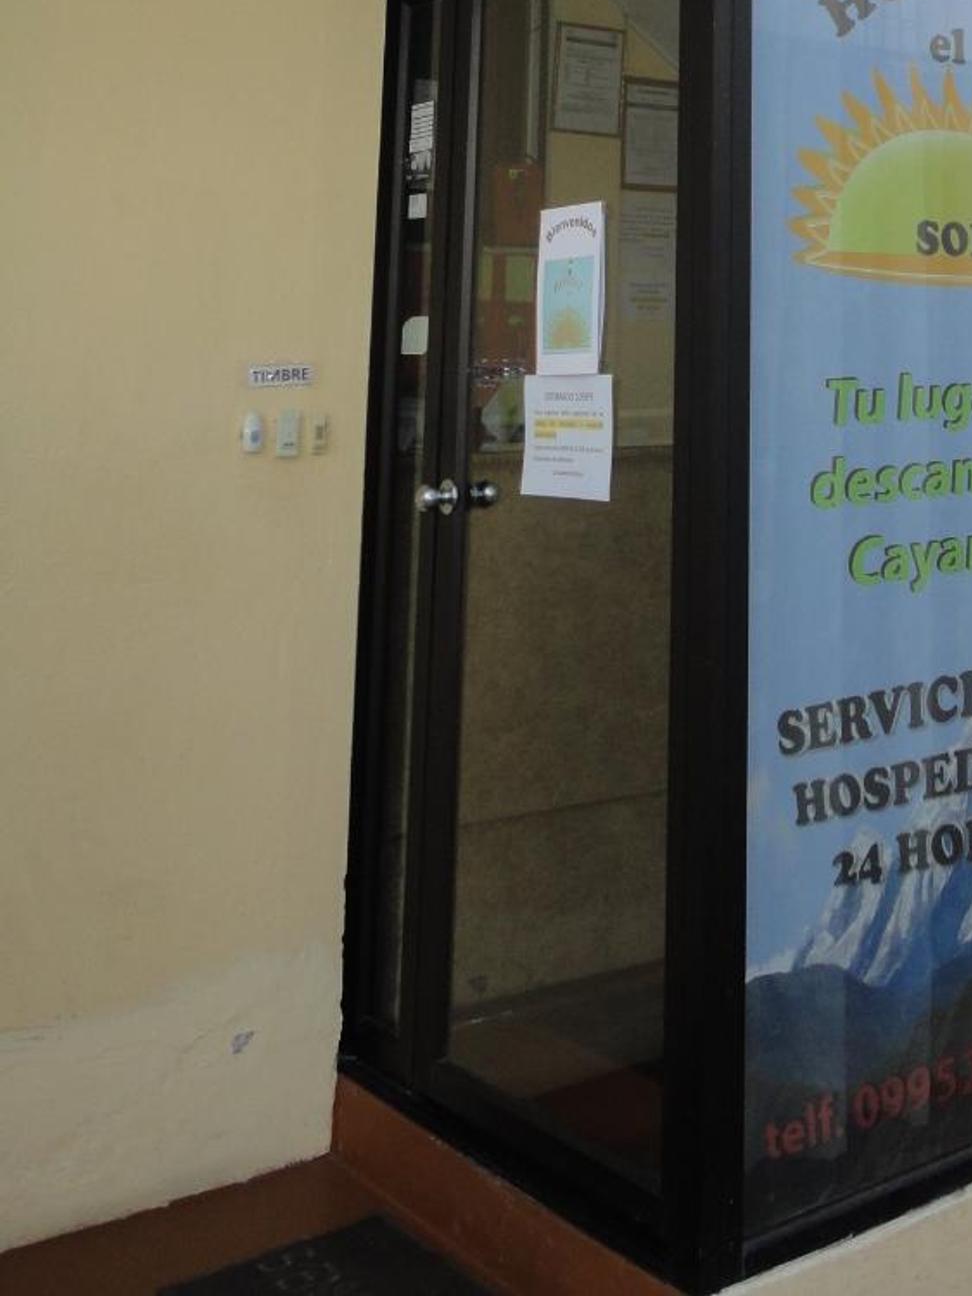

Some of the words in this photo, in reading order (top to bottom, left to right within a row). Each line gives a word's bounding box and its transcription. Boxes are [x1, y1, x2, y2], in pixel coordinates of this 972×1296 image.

[928, 28, 966, 65] el
[252, 367, 311, 384] TIMBRE
[826, 375, 887, 425] Tu
[832, 844, 883, 888] 24
